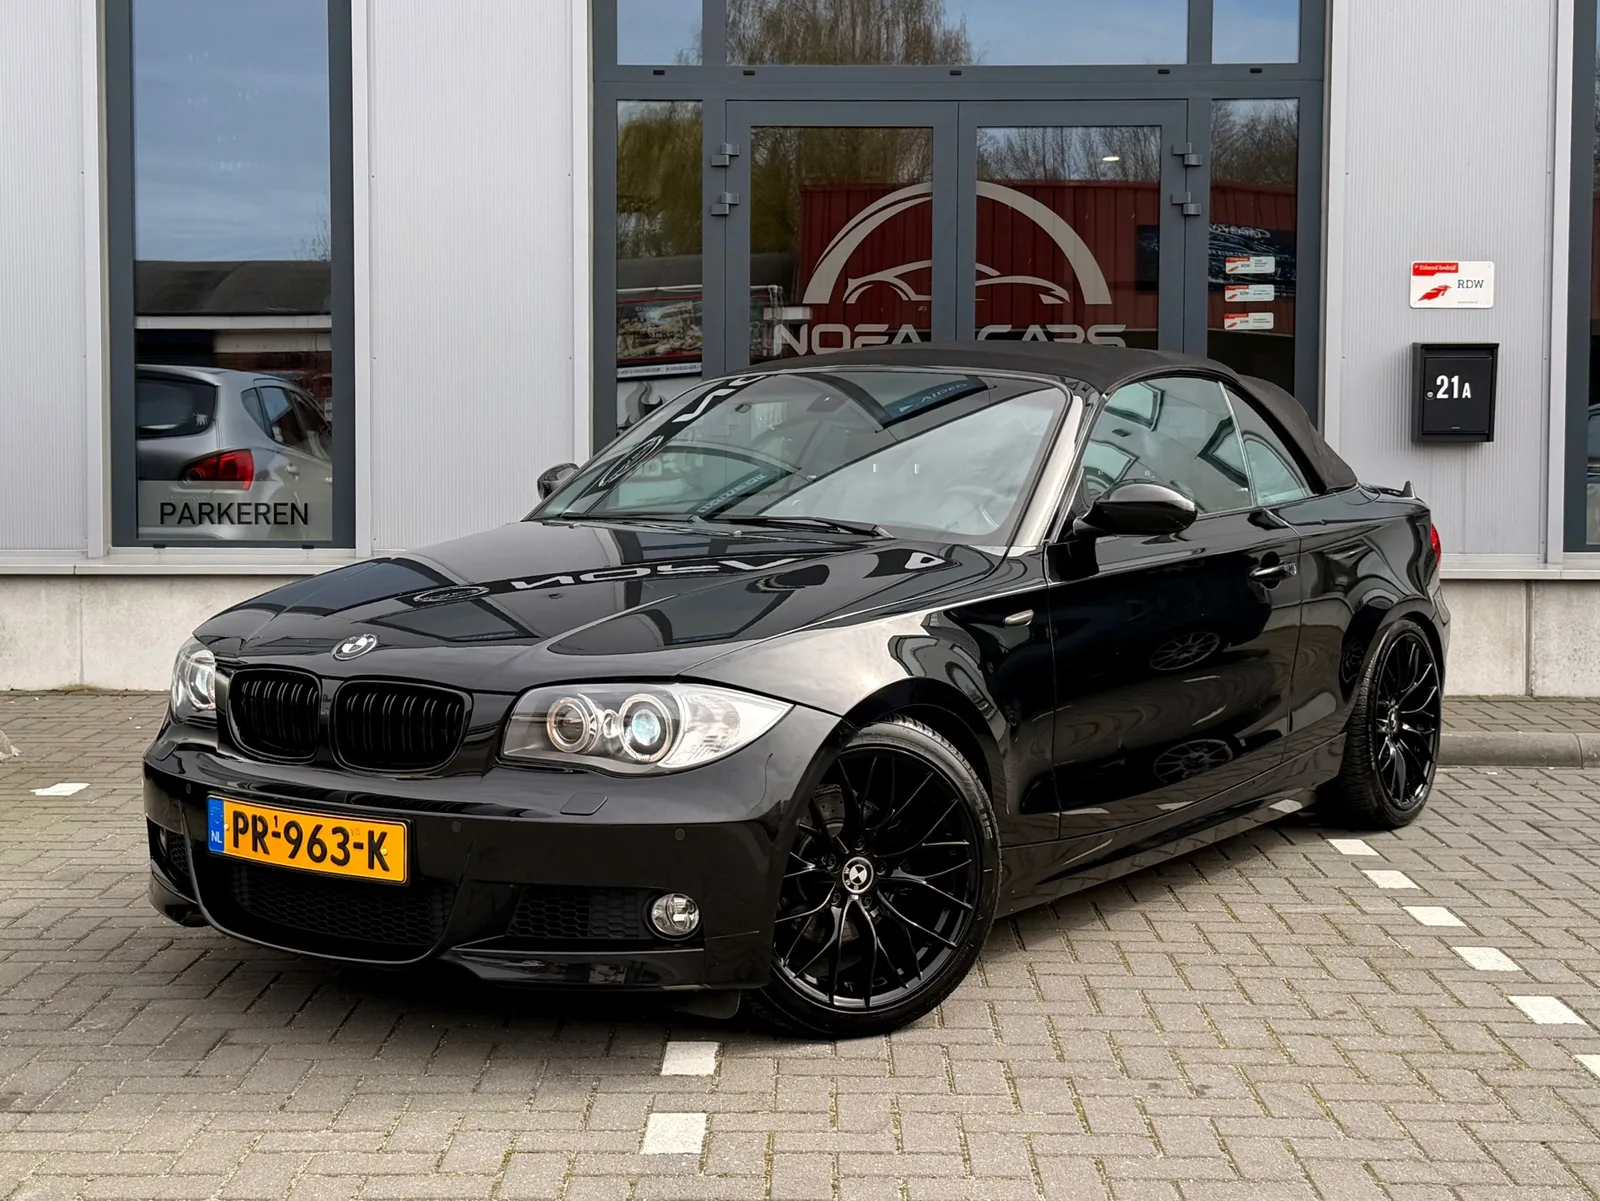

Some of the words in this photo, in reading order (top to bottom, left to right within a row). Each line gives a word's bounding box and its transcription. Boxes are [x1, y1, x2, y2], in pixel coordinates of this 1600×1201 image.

[1457, 279, 1485, 289] RDW
[774, 323, 923, 356] NOFA
[160, 502, 309, 525] PARKEREN
[211, 830, 223, 844] NL
[232, 810, 391, 872] PR-963-K
